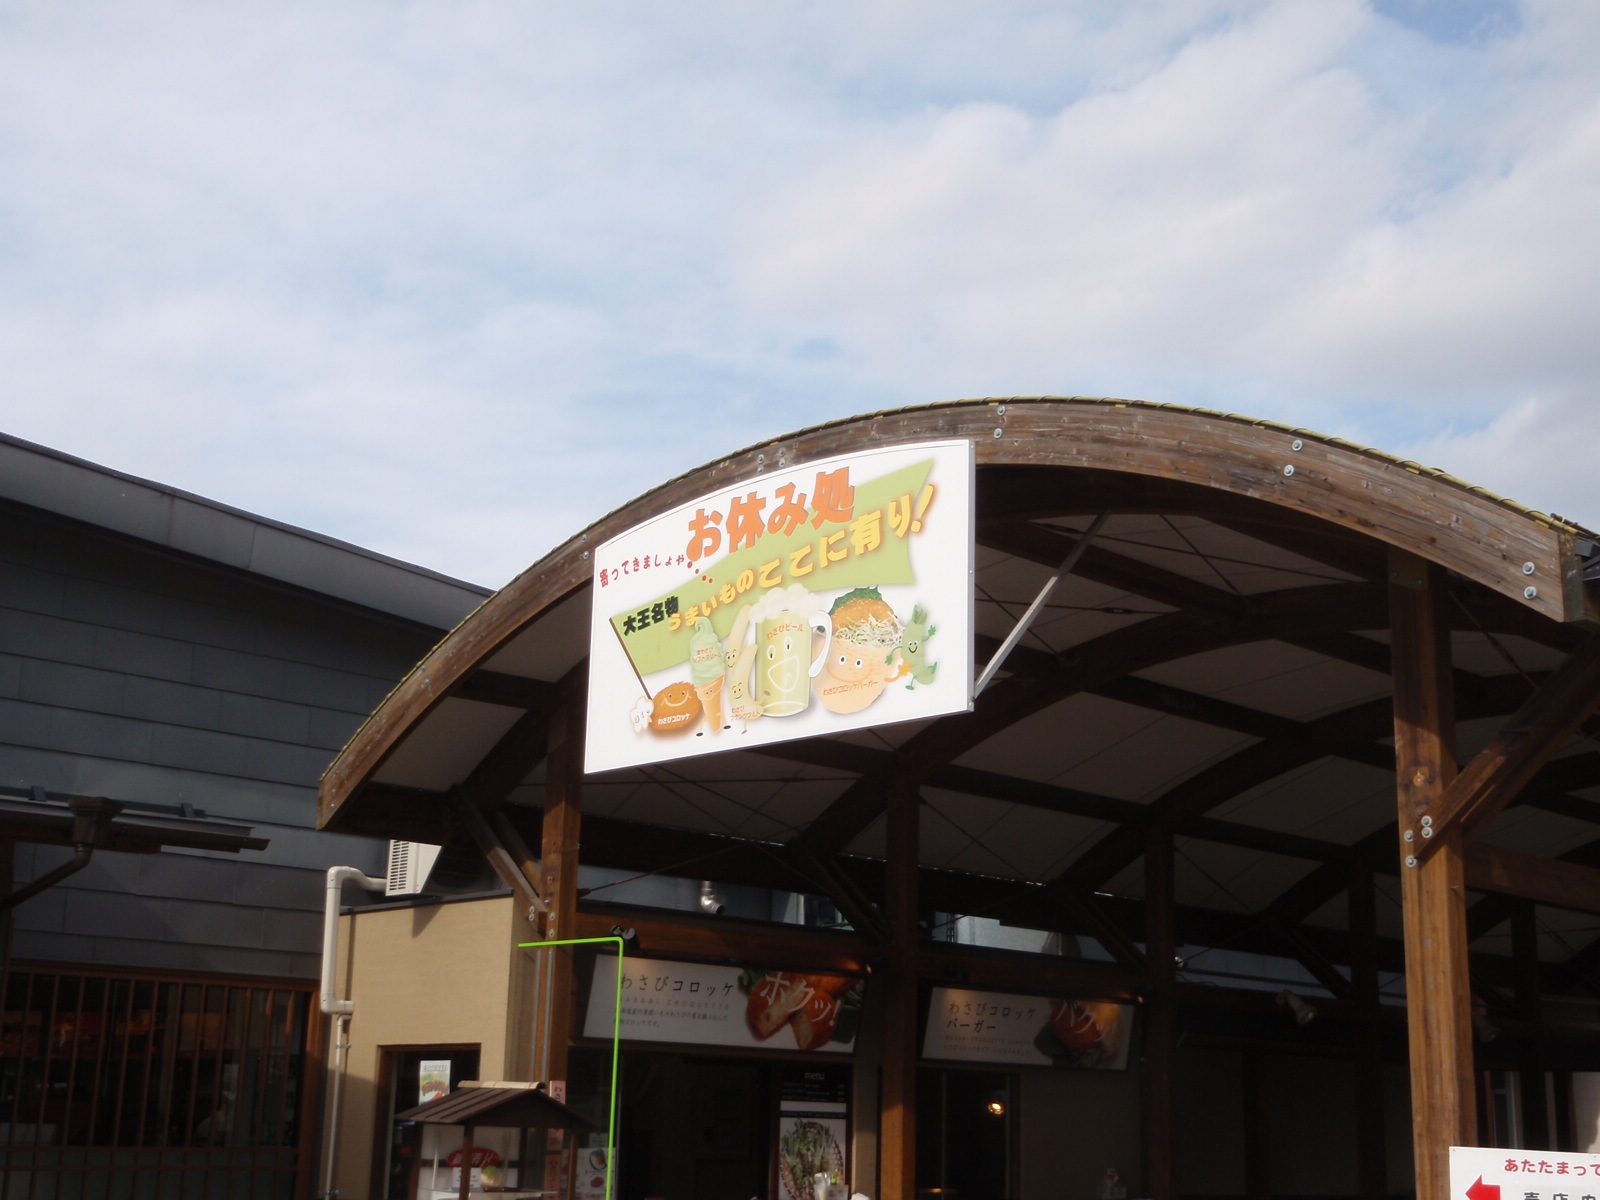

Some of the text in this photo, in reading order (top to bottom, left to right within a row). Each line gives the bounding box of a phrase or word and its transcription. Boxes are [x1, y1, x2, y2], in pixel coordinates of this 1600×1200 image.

[686, 466, 855, 562] お休み処
[623, 596, 679, 636] 大王名物
[620, 973, 735, 996] わさびコロッケ
[949, 999, 1037, 1021] わさびコロッケ
[1504, 1158, 1600, 1177] あたたまって
